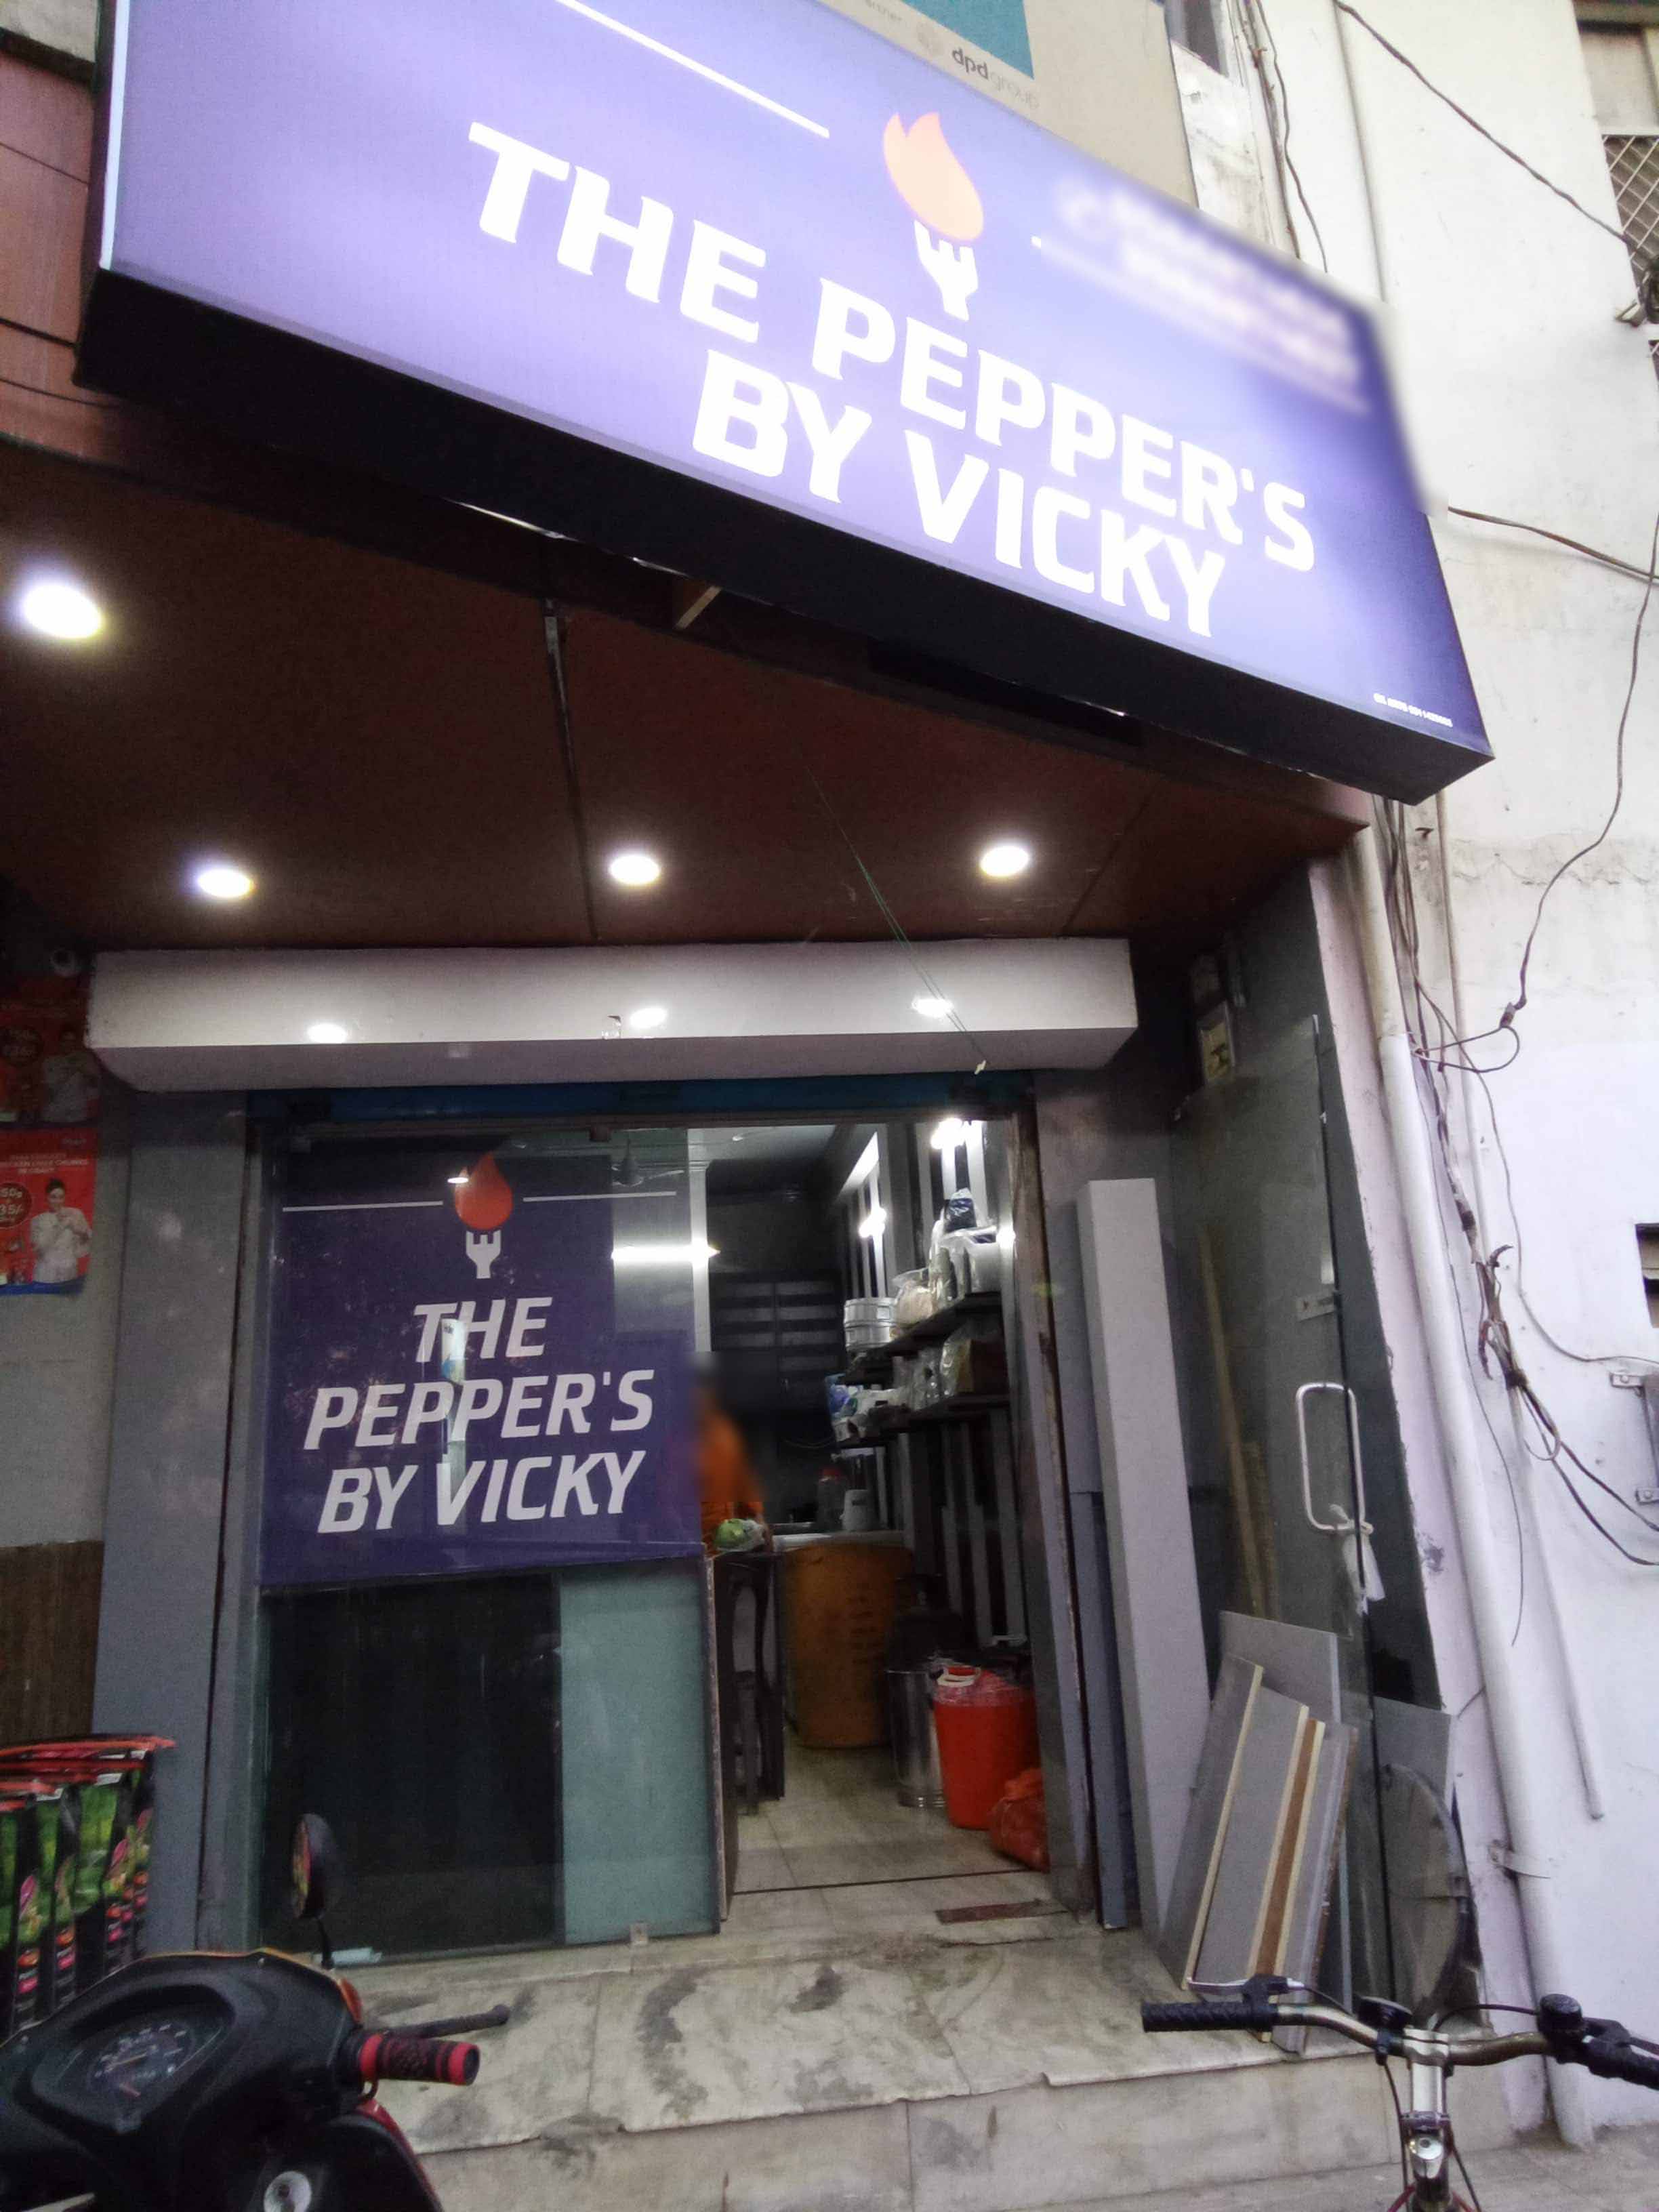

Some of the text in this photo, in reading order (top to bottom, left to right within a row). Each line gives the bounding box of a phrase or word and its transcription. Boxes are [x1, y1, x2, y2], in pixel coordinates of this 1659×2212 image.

[468, 121, 767, 344] THE
[812, 278, 1315, 572] PEPPER'S
[692, 348, 1225, 638] BY VICKY
[413, 1297, 552, 1363] THE
[304, 1369, 655, 1450] PEPPER'S
[317, 1450, 647, 1534] BY VICKY
